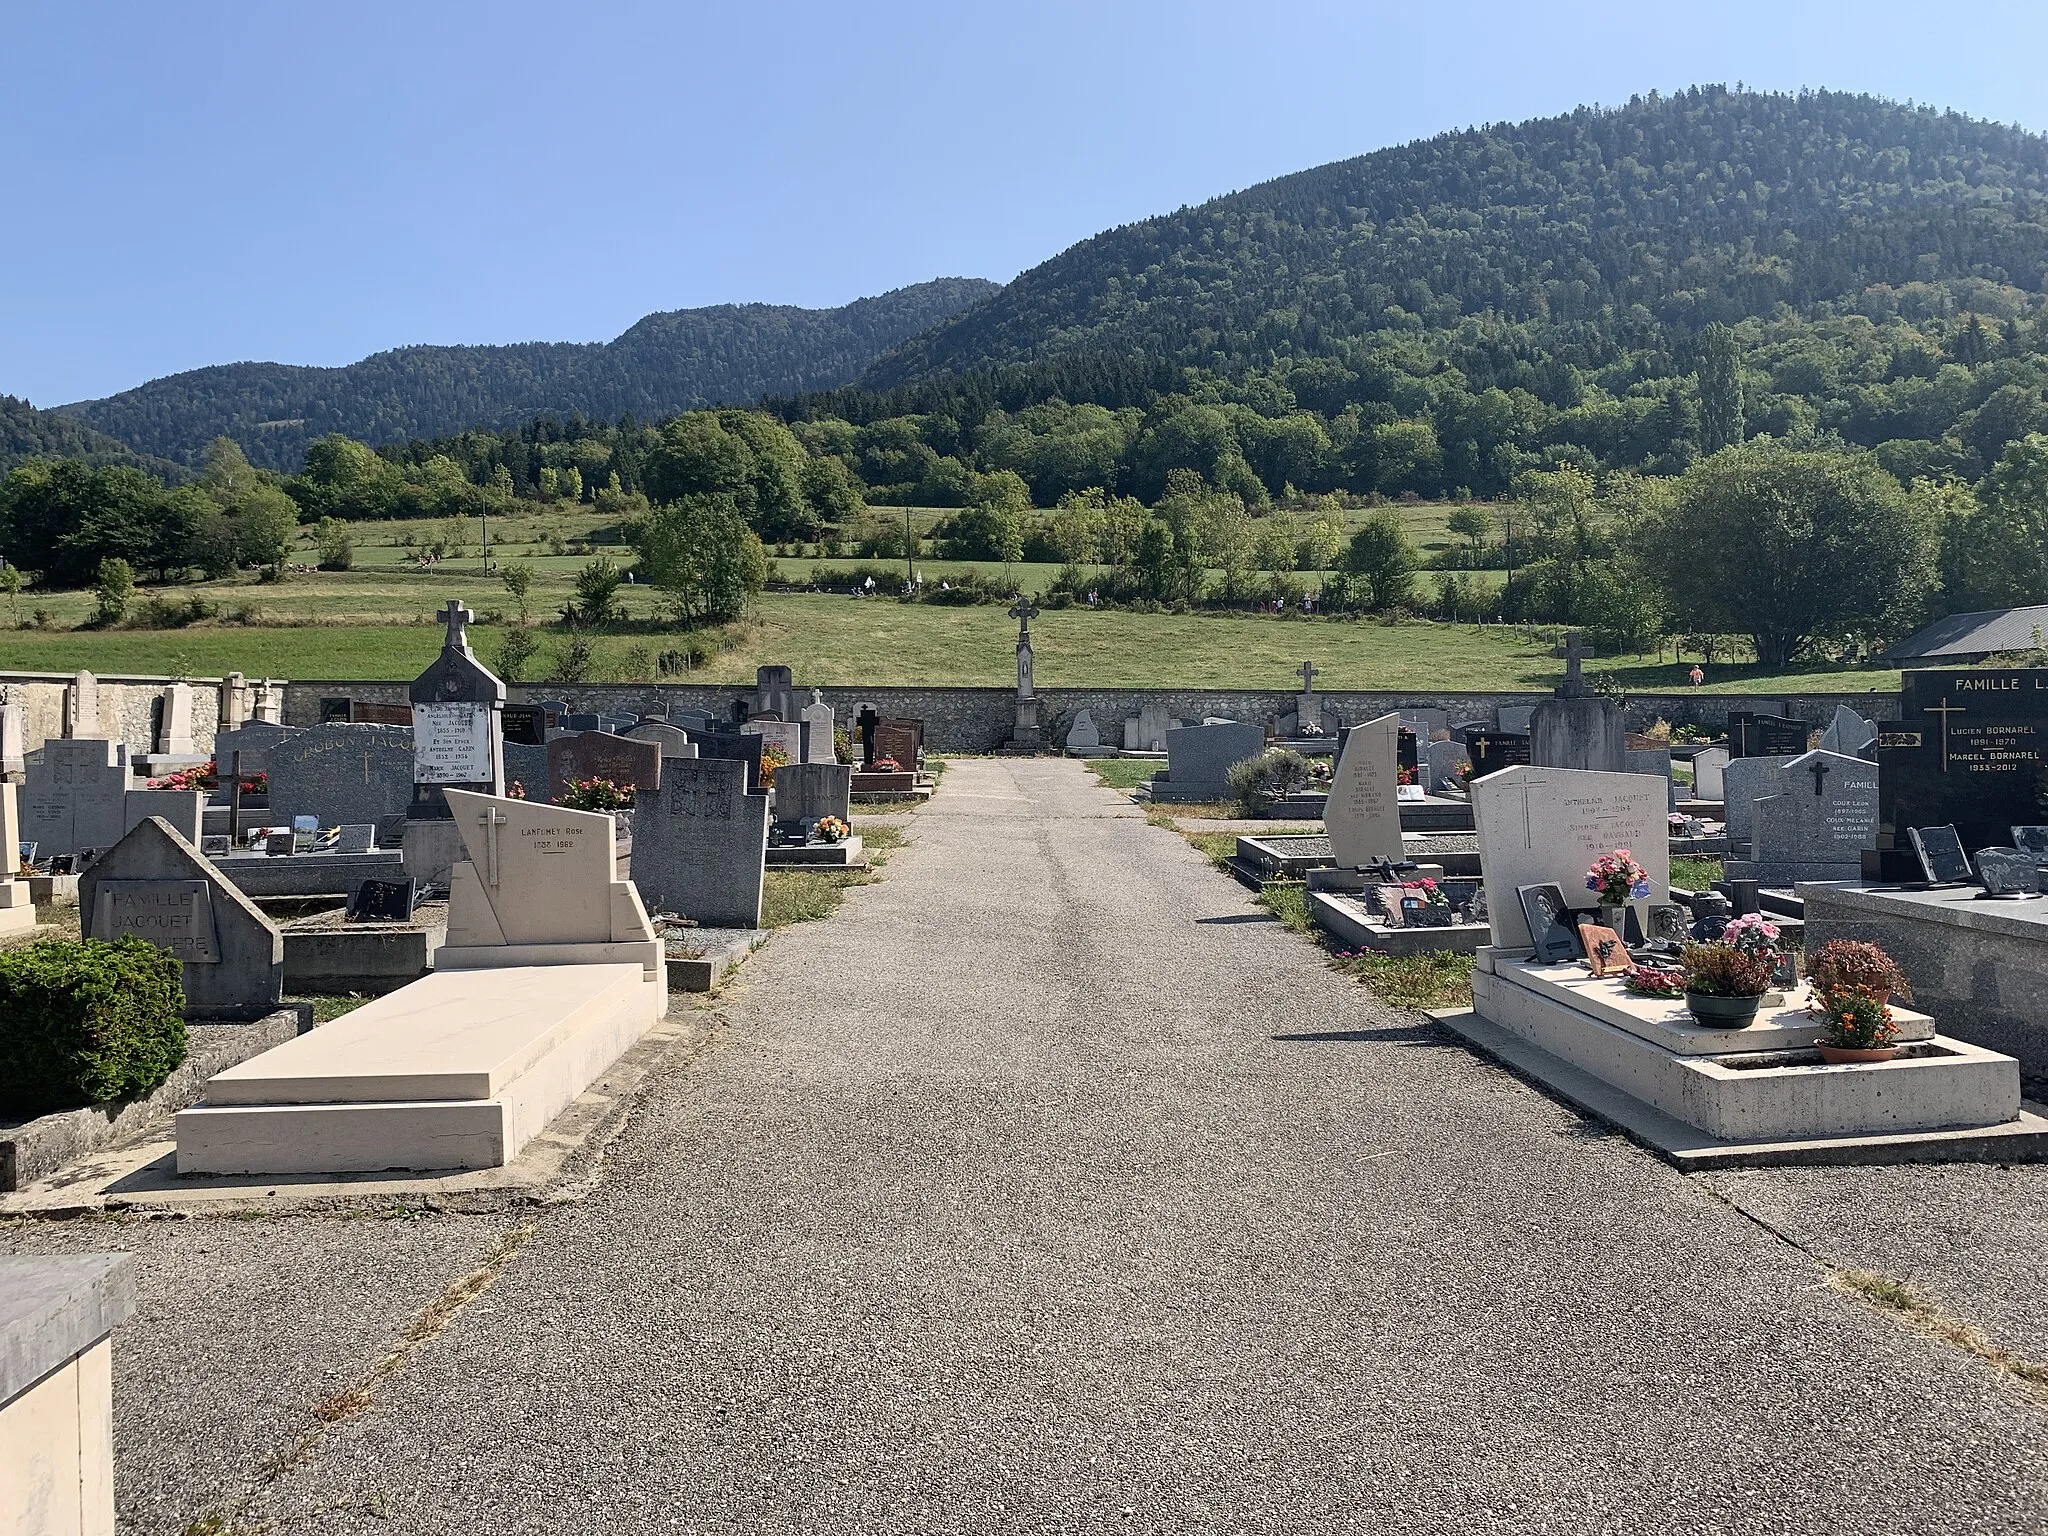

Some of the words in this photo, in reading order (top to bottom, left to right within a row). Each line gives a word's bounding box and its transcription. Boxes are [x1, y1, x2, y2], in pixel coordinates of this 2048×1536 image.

[1955, 678, 2020, 690] FAMILLE
[1950, 727, 1982, 735] LUCIEN
[1986, 726, 2036, 735] BORNAREL
[366, 735, 415, 750] JACQ
[1949, 753, 1986, 761] MARCEL
[1990, 751, 2040, 760] BORNAREL
[1614, 793, 1650, 803] JACQUET
[1569, 823, 1599, 831] SIMONE
[113, 893, 192, 906] FAMILLE
[112, 915, 192, 928] JACQUET
